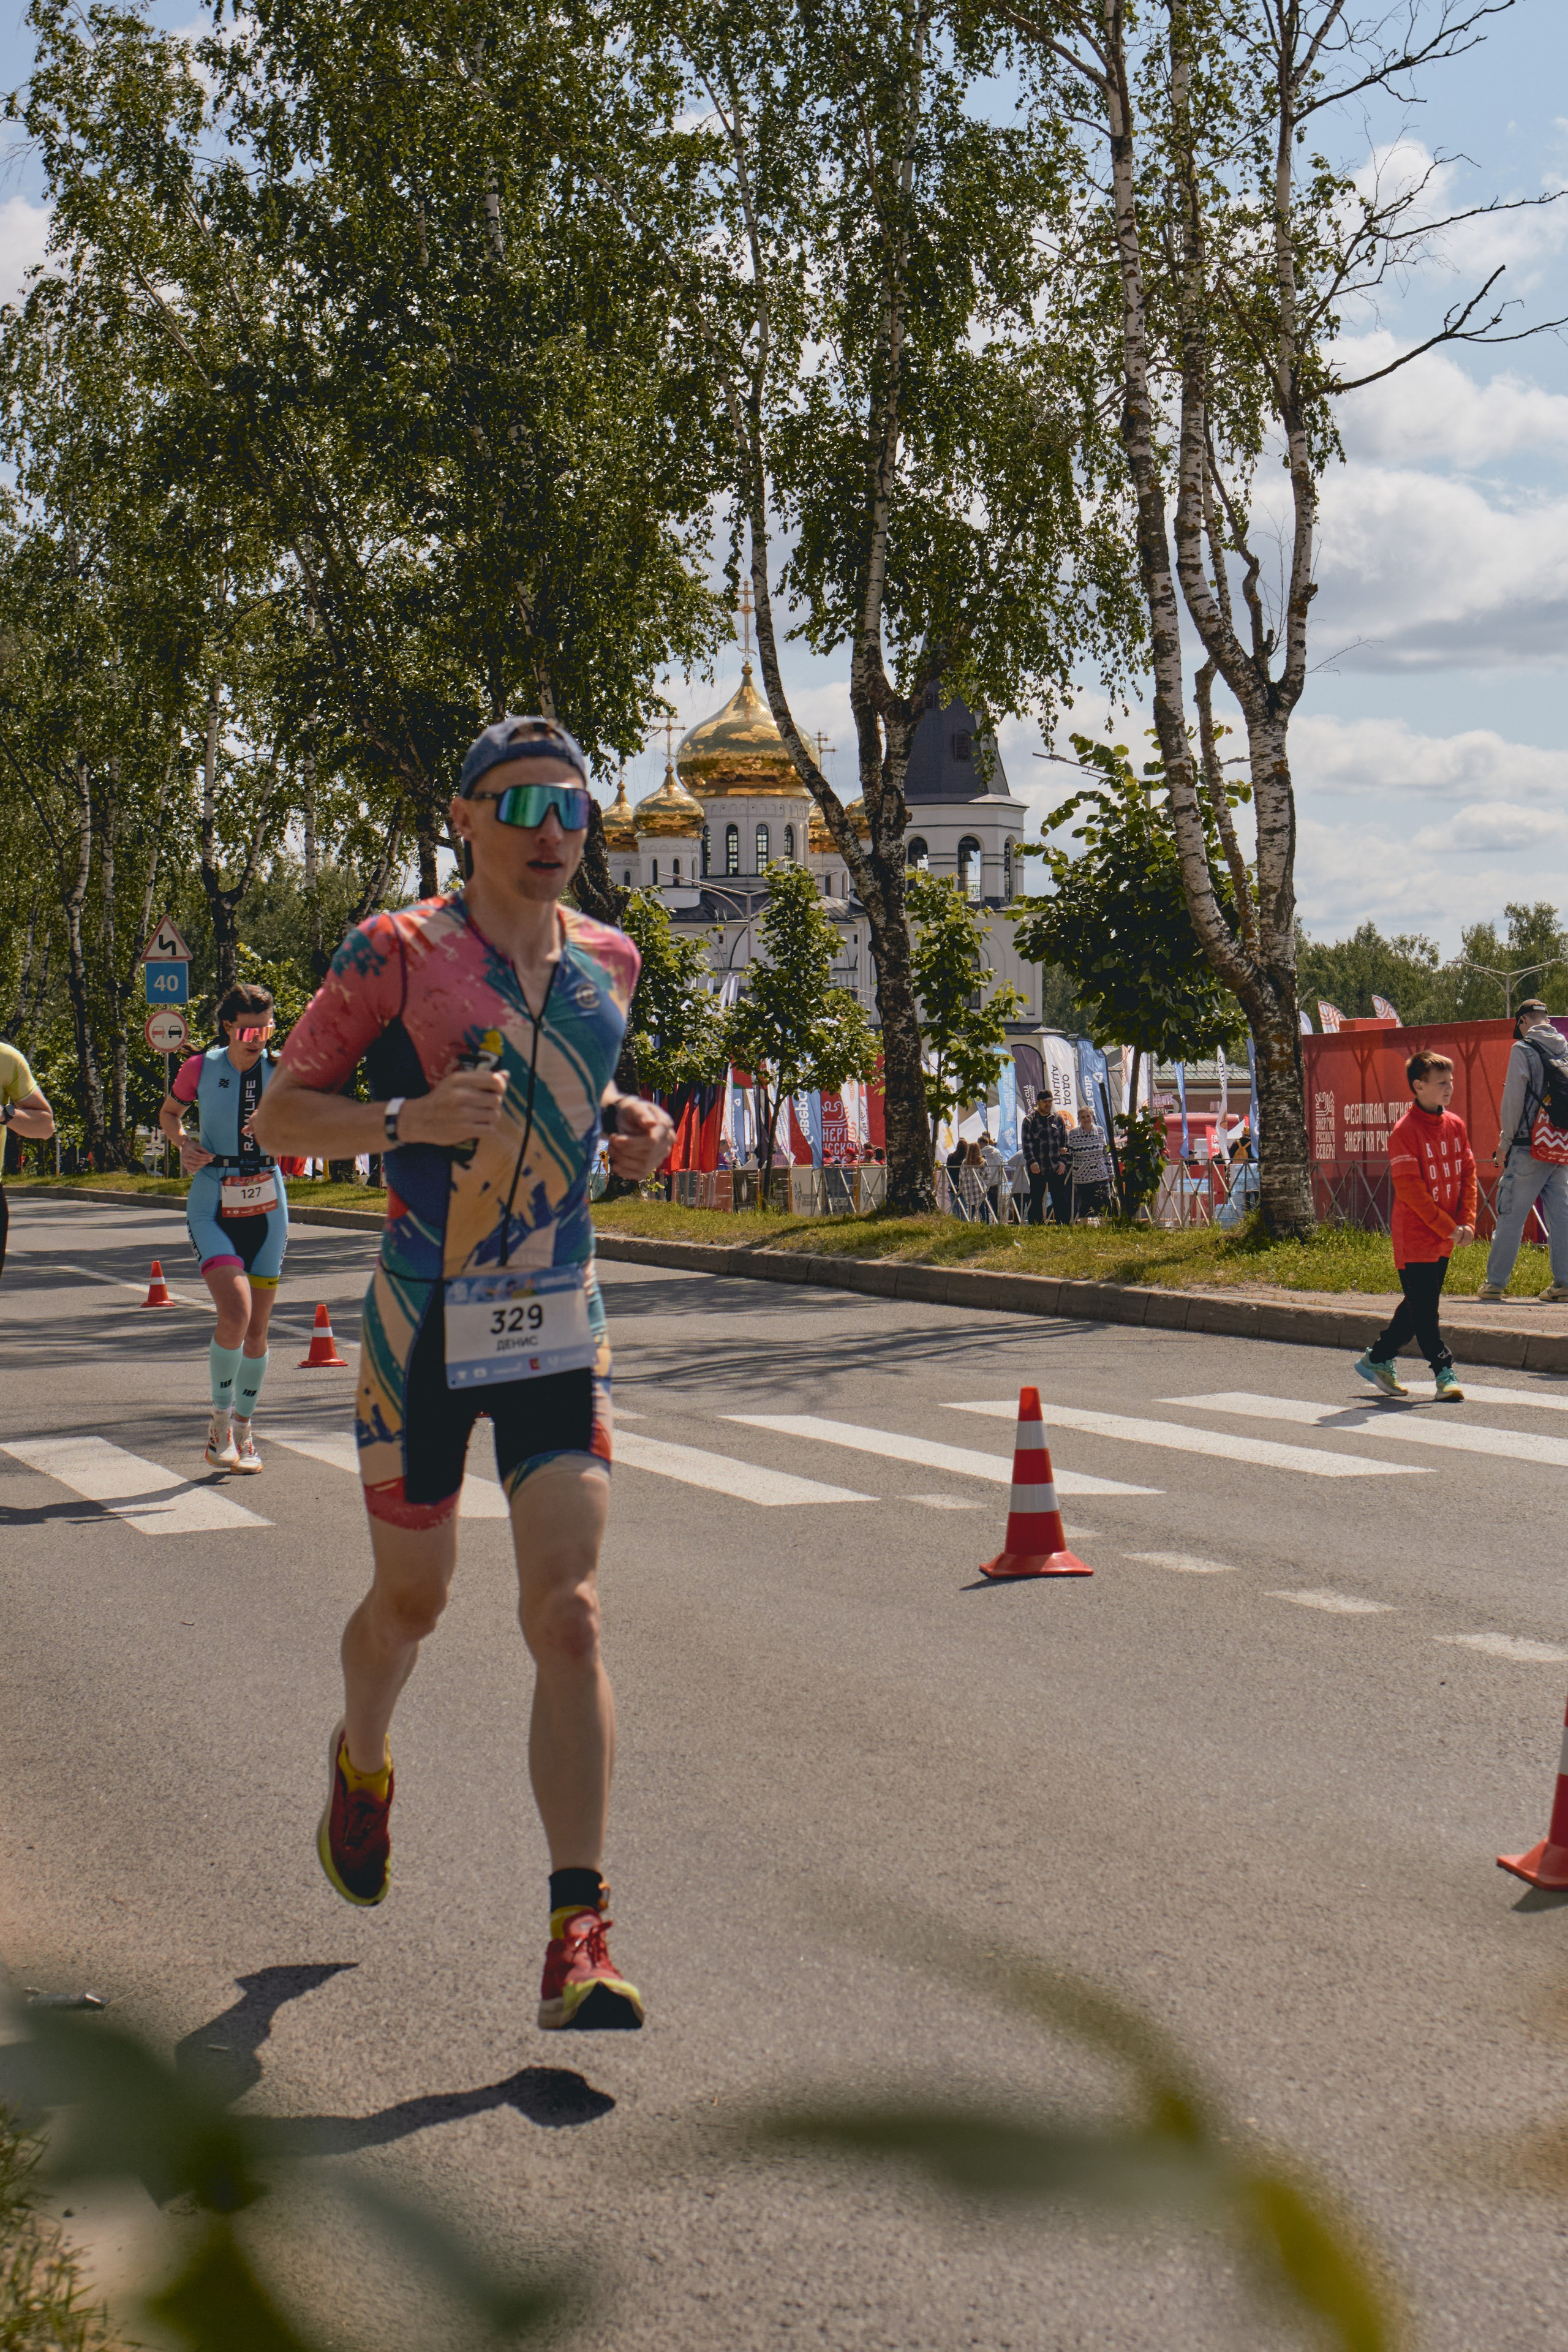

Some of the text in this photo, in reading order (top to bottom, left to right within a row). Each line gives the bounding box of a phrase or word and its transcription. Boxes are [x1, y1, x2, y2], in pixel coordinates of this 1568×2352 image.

[153, 974, 179, 992] 40
[244, 1080, 255, 1110] LIFE
[1344, 1103, 1387, 1125] ФЕСТИВАЛЬ
[1316, 1117, 1335, 1131] ЭНЕРГИЯ
[823, 1128, 848, 1142] НЕРГ
[1316, 1131, 1335, 1143] РУССКОГО
[1344, 1131, 1392, 1152] ЭНЕРГИЯ РУС
[1316, 1144, 1335, 1159] СЕВЕРА
[241, 1186, 261, 1199] 127
[490, 1304, 543, 1335] 329
[496, 1336, 539, 1352] ДЕНИС
